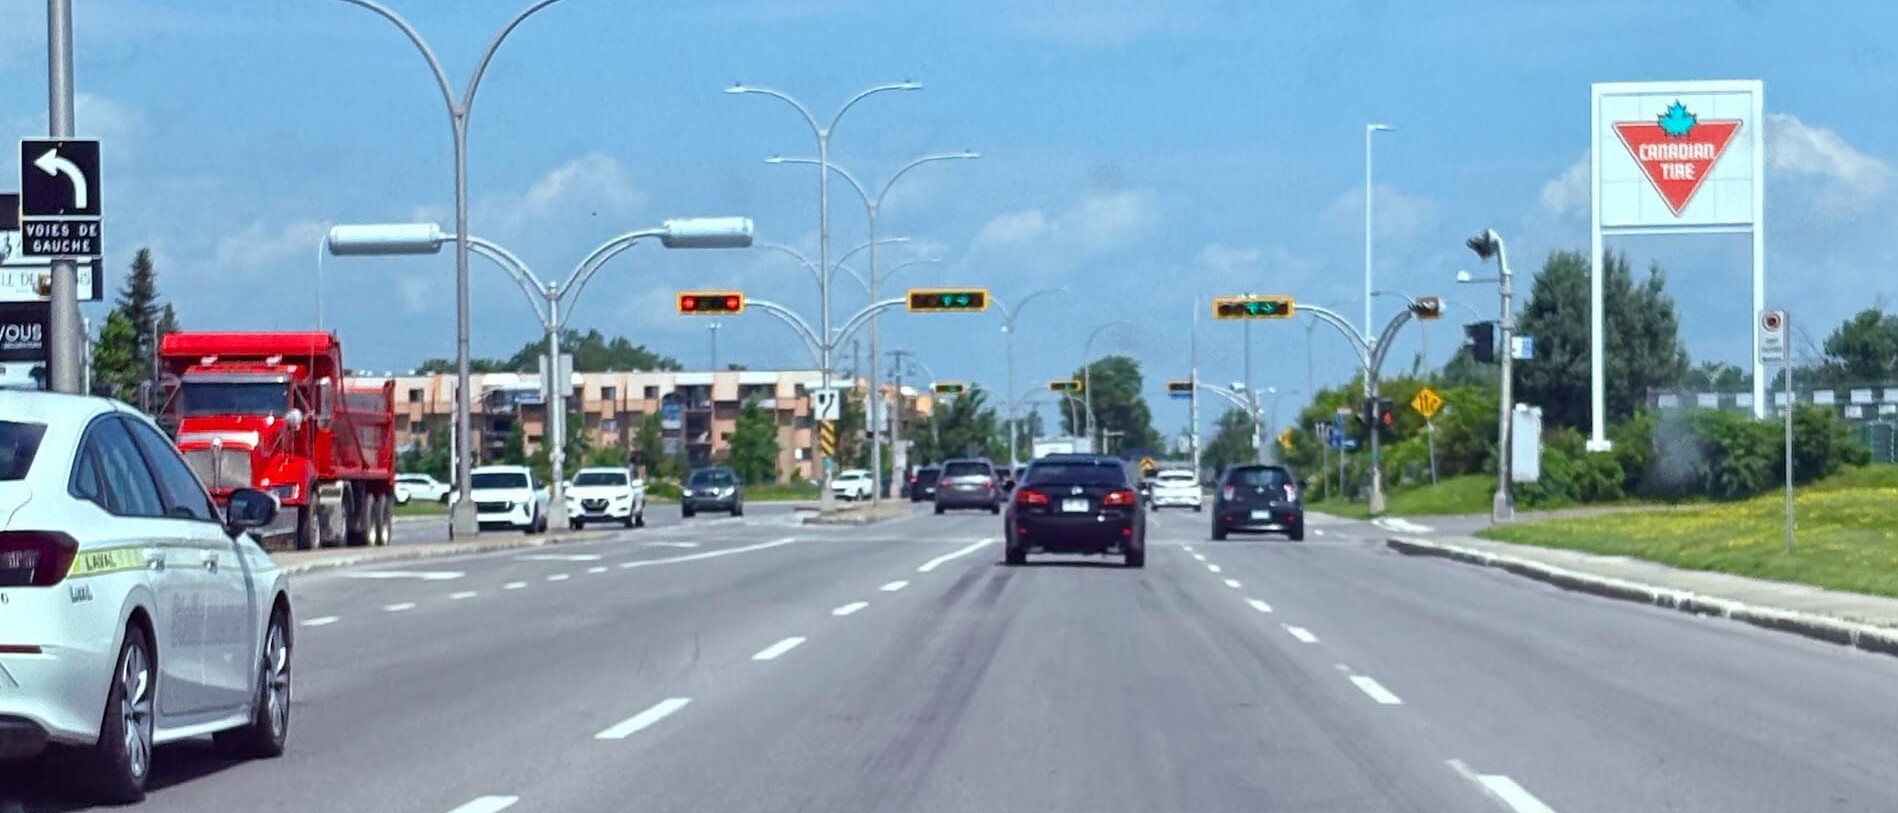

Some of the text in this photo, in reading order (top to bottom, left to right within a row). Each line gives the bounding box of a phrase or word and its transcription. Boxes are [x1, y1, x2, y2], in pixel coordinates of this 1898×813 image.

[1639, 143, 1715, 161] CANADIAN
[1660, 163, 1696, 181] TIRE
[26, 223, 98, 237] VOIES DE
[32, 239, 91, 253] GAUCHE
[85, 551, 117, 571] LAVAL
